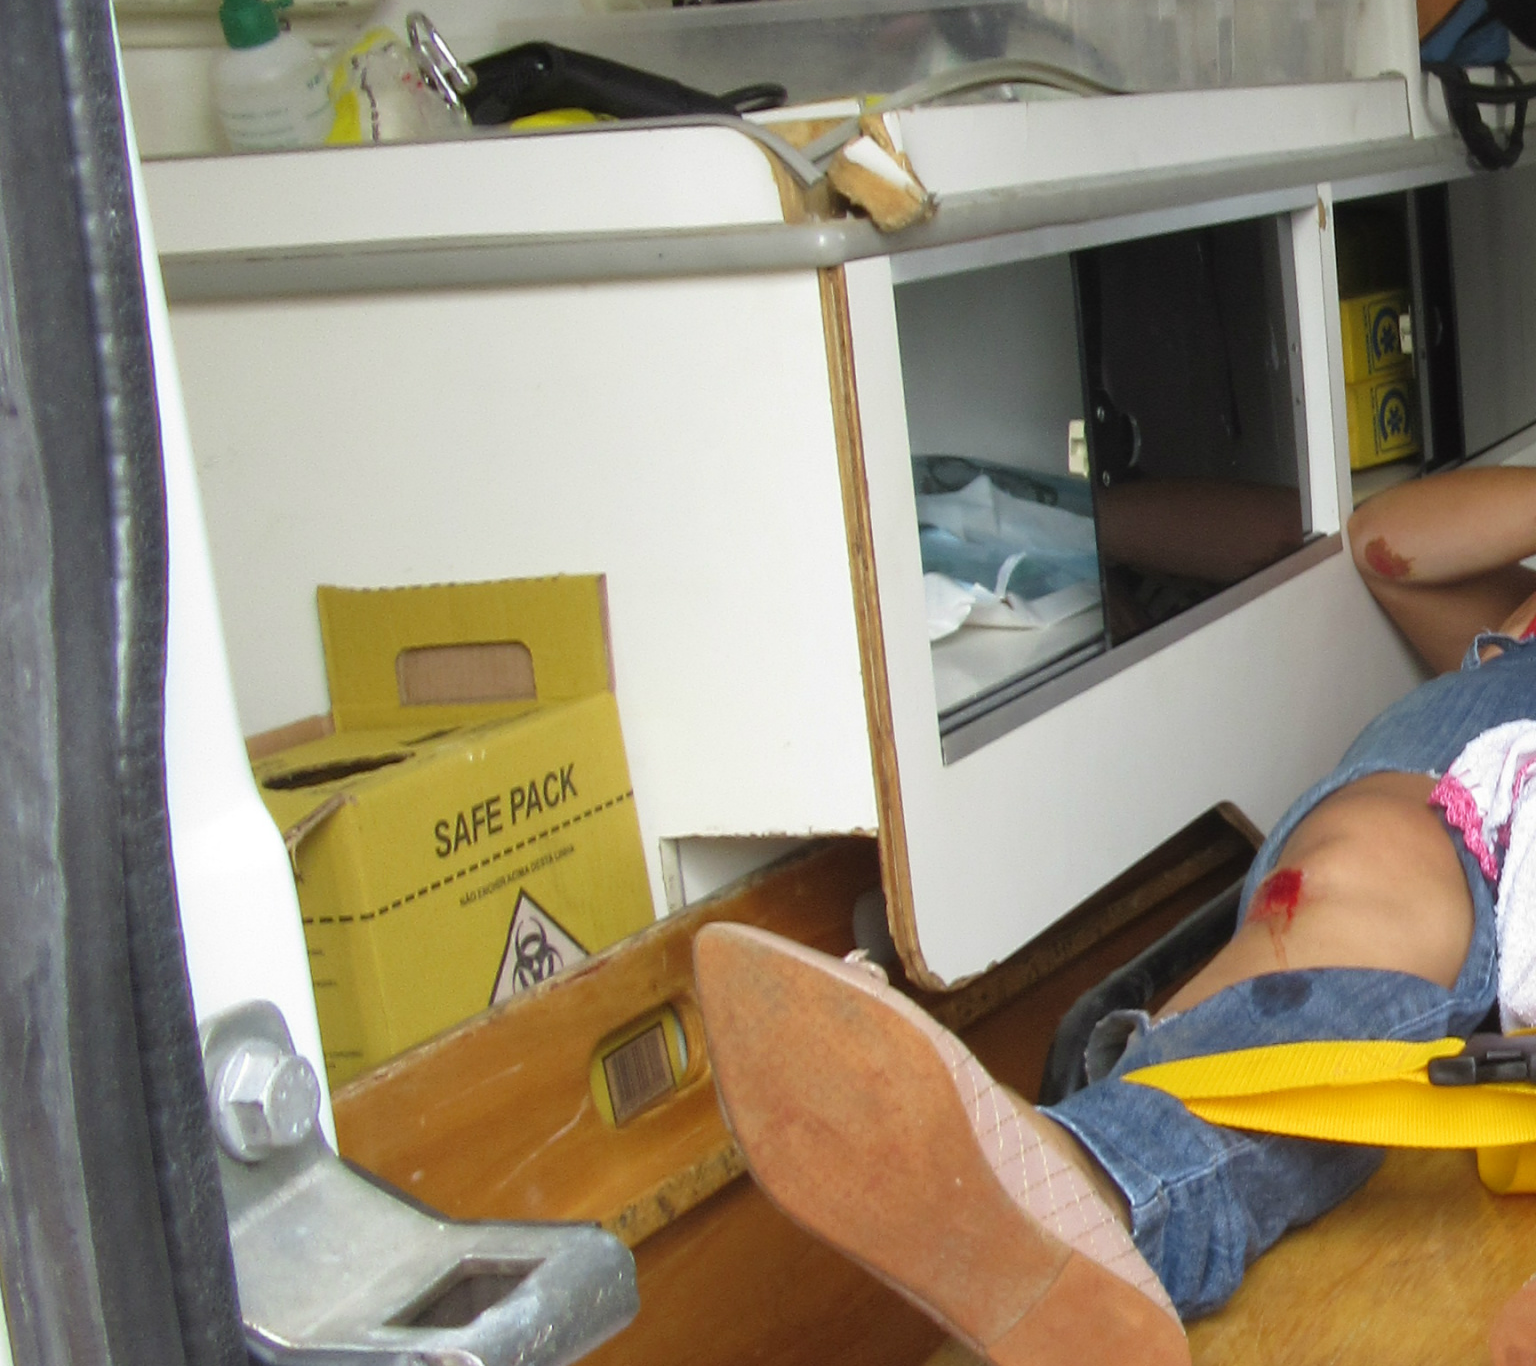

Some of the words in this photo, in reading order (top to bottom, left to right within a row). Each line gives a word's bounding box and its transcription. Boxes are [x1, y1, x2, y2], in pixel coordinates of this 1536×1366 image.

[434, 794, 503, 858] SAFE
[509, 762, 578, 826] PACK
[459, 891, 477, 906] NÃO
[507, 865, 530, 884] ACIMA
[530, 854, 554, 874] DESTA
